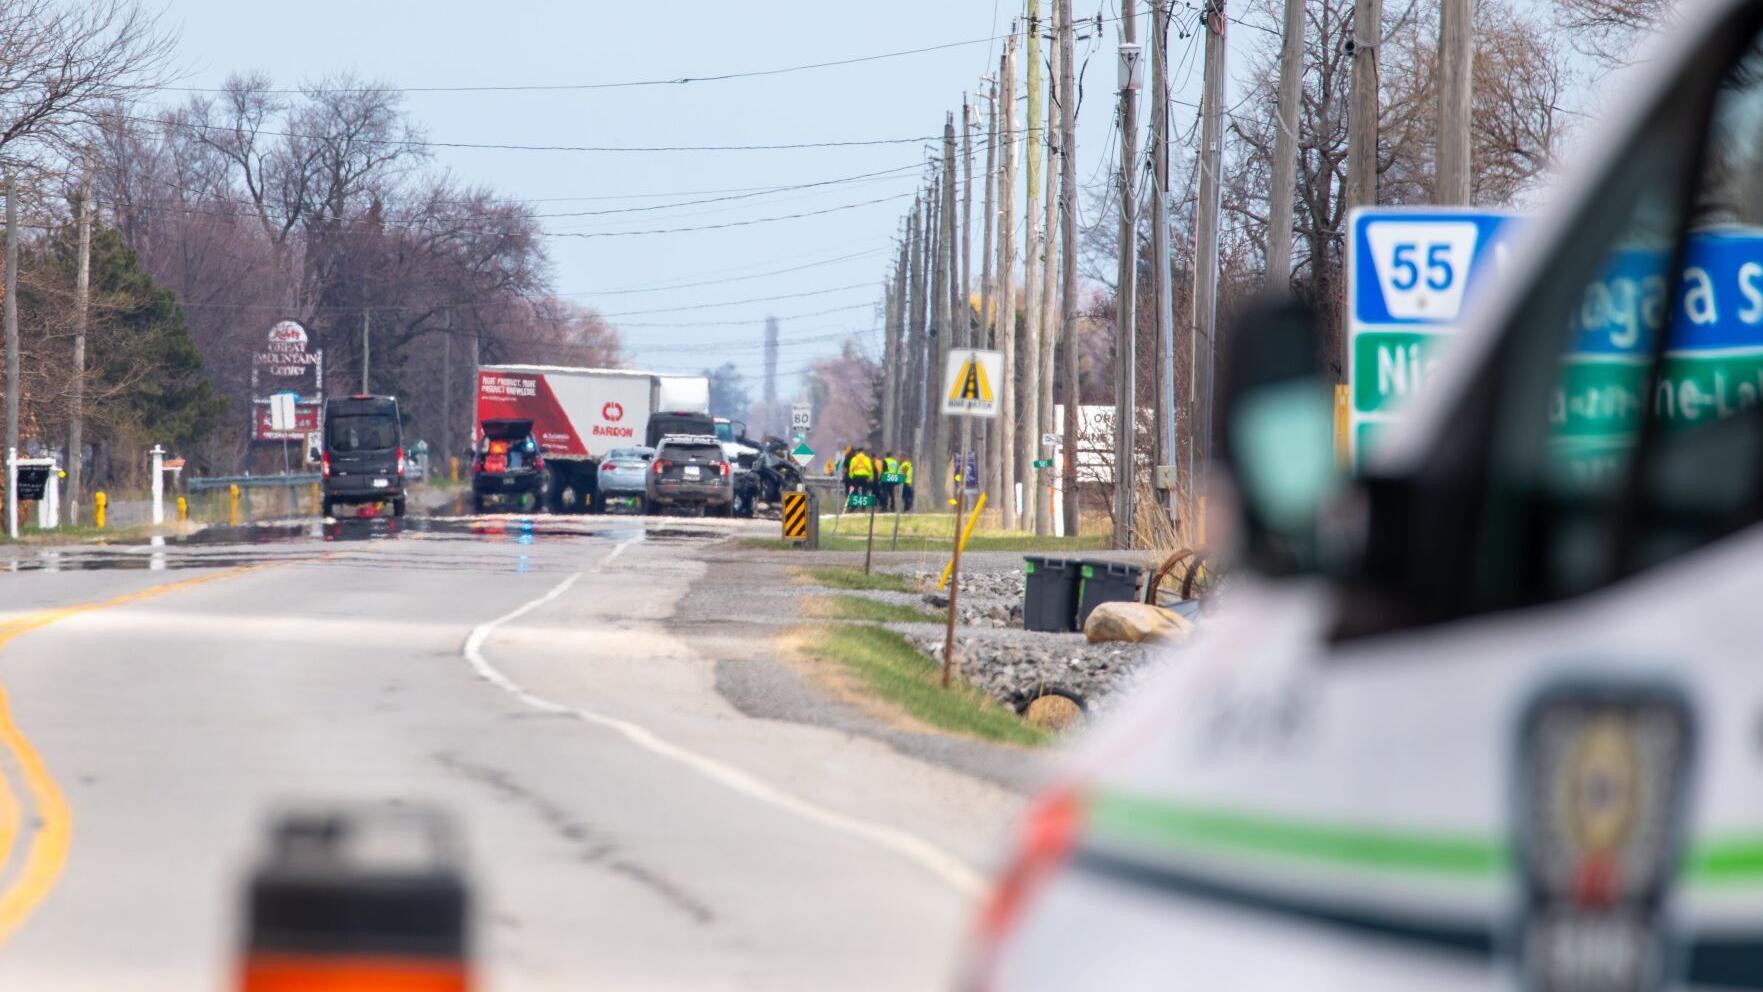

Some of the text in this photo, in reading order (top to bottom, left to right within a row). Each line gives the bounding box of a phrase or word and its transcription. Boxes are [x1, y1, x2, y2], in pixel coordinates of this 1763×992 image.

[1391, 243, 1455, 292] 55
[256, 353, 318, 366] MOUNTAIN
[482, 376, 496, 385] MORE
[522, 379, 537, 388] MORE
[481, 385, 505, 394] PRODUCT
[794, 414, 809, 424] 80
[592, 425, 633, 438] BARDON
[852, 495, 868, 506] 545
